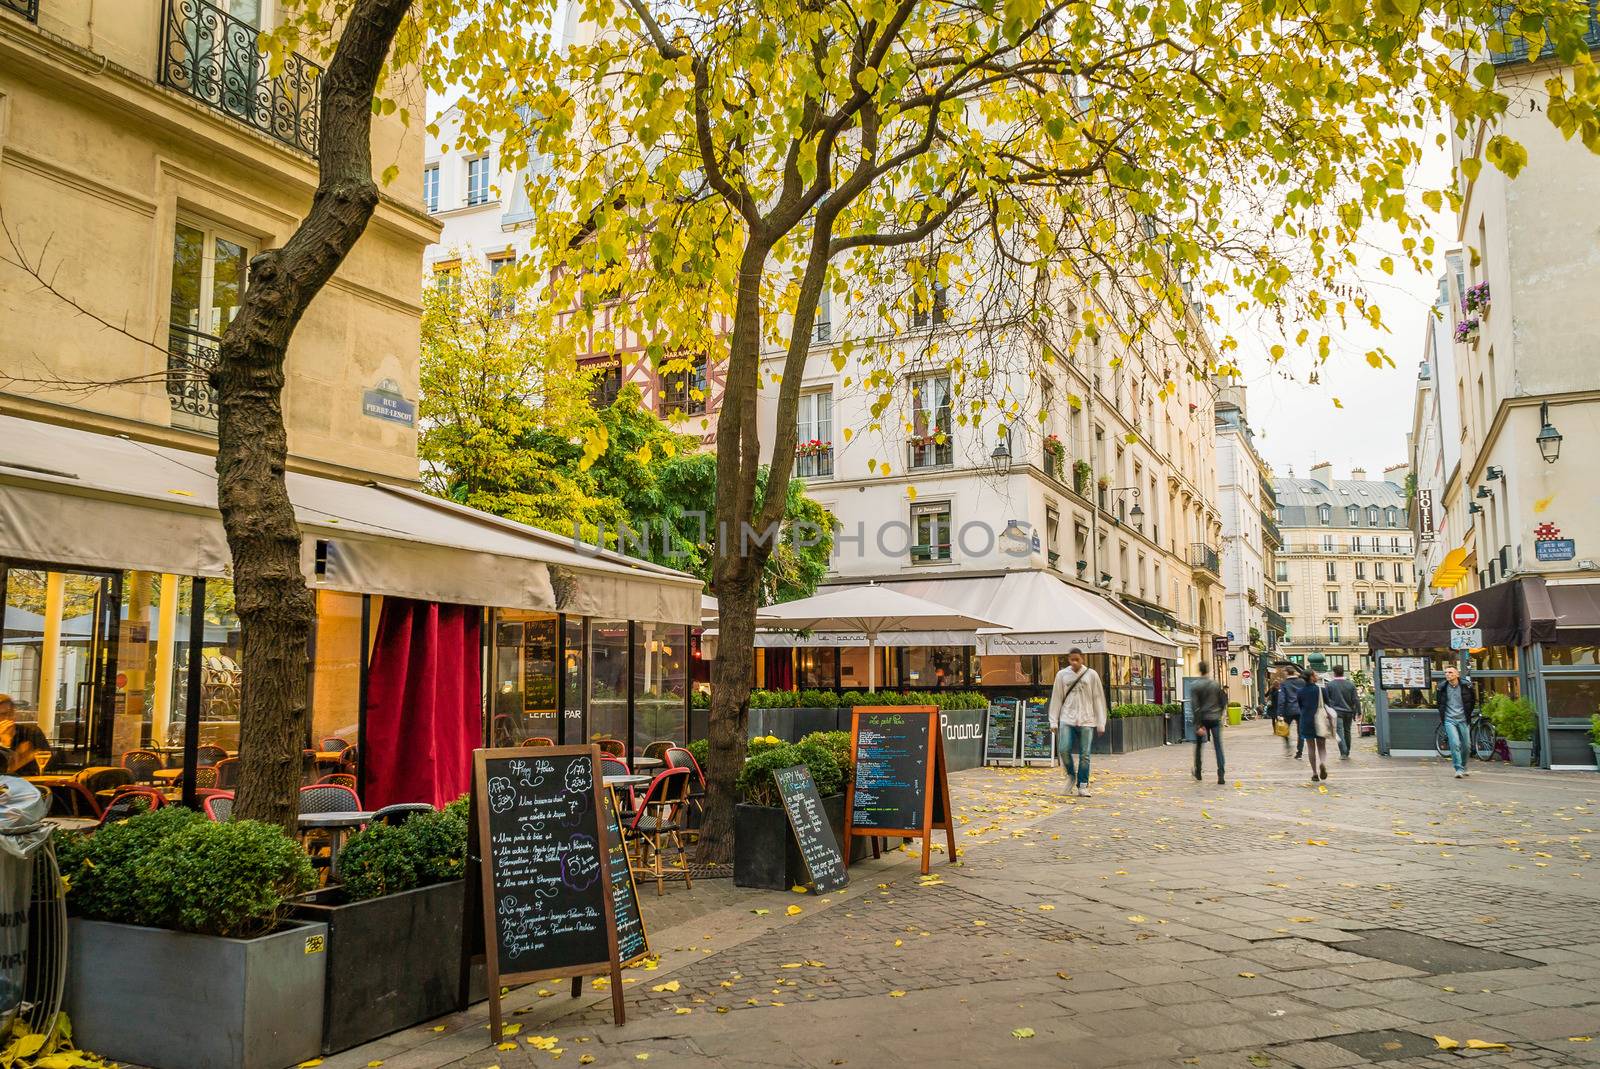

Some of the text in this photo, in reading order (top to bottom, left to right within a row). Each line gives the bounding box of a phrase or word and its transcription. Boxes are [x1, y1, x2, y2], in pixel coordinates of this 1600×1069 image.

[383, 398, 398, 408] RUE
[366, 404, 412, 421] PIERRE-LESCOT
[1420, 490, 1431, 532] HOTEL
[1071, 636, 1102, 649] café
[940, 714, 982, 740] Paname
[509, 760, 532, 780] Happy
[570, 765, 585, 776] 17h
